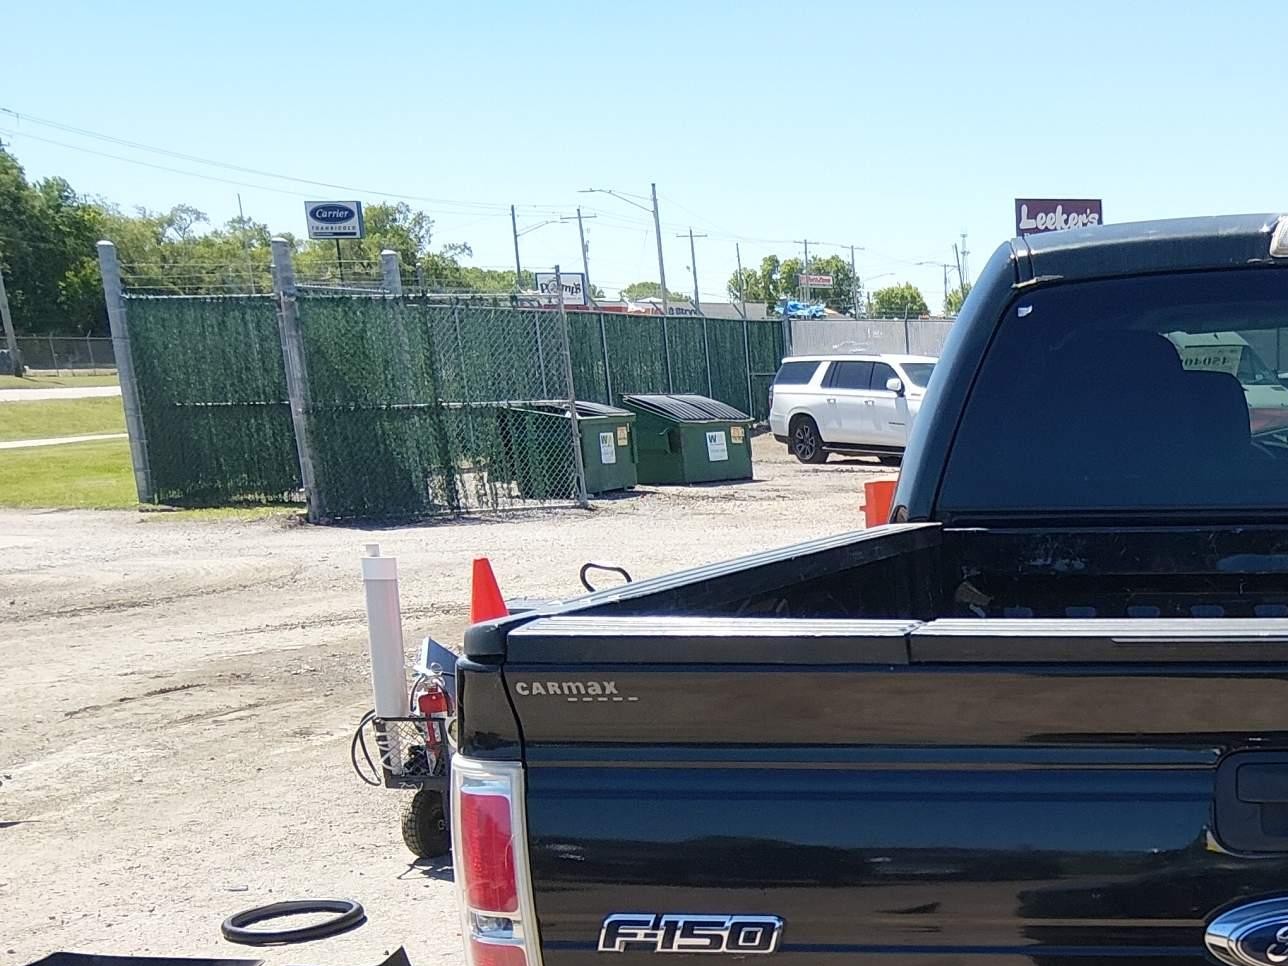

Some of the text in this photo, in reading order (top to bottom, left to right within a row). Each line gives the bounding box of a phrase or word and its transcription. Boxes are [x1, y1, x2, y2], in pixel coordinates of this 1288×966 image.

[315, 208, 349, 218] Carrier
[1019, 204, 1099, 231] Leeker's
[598, 914, 785, 953] F-150
